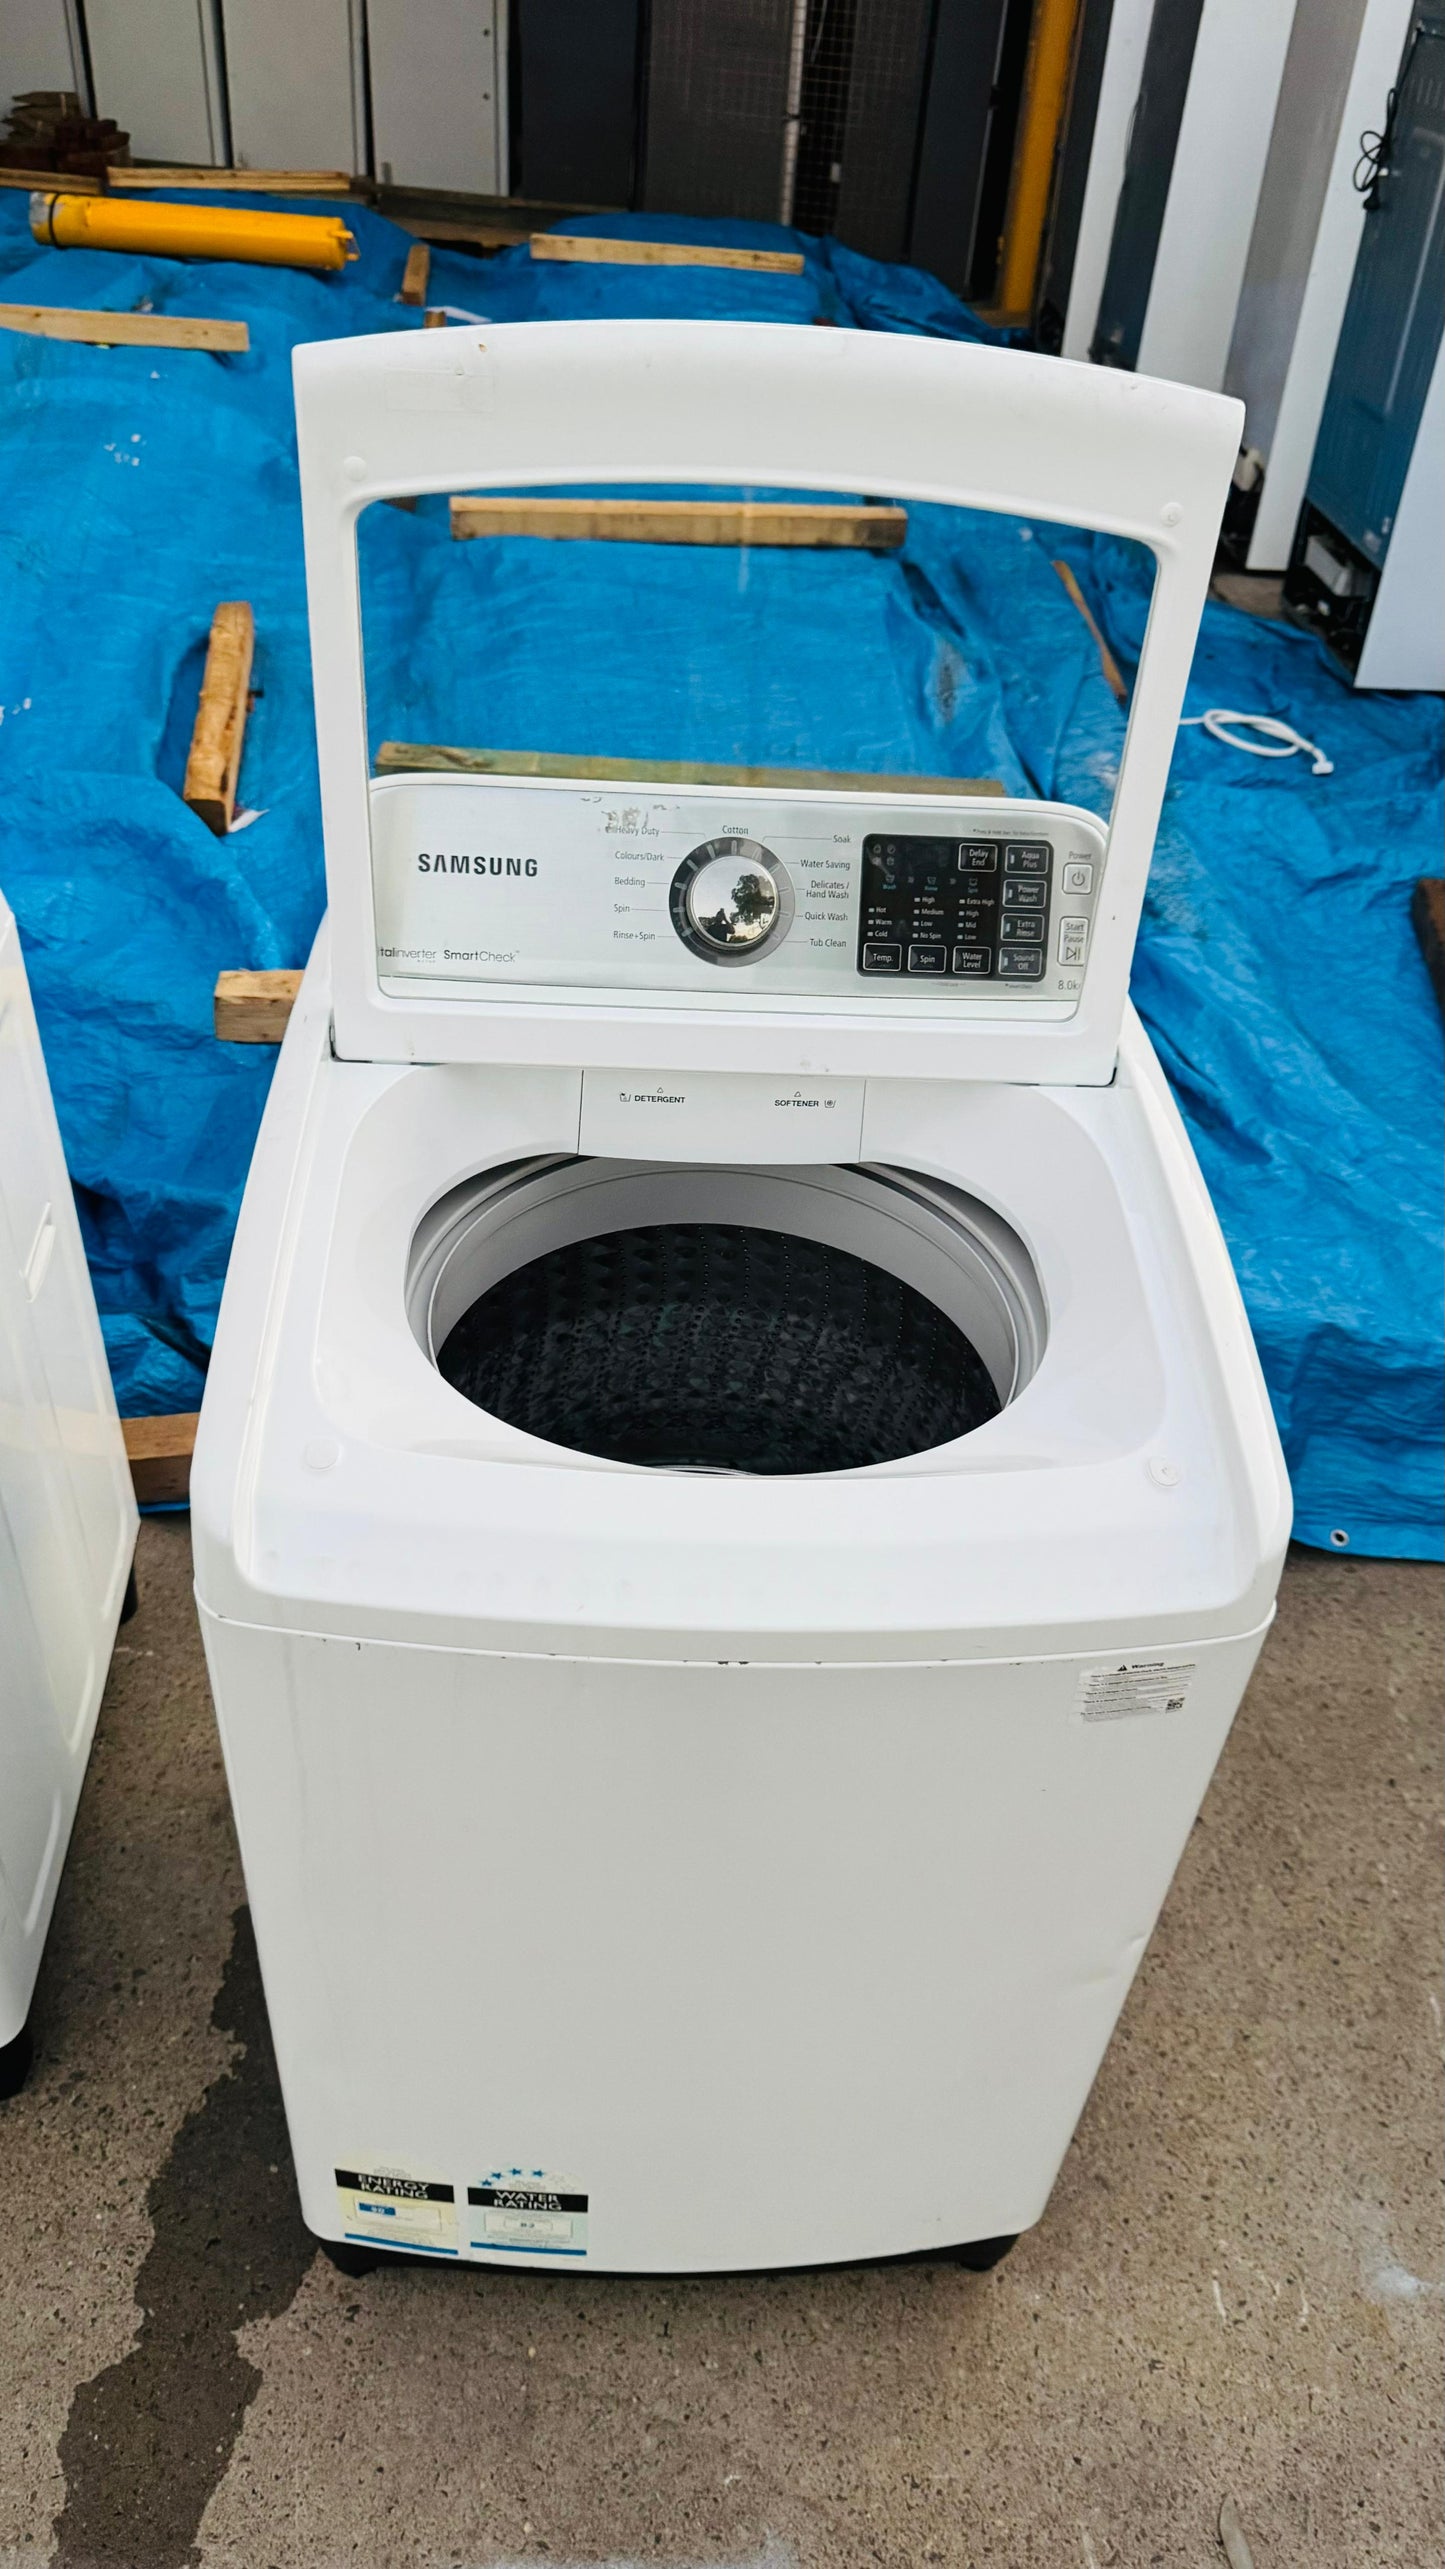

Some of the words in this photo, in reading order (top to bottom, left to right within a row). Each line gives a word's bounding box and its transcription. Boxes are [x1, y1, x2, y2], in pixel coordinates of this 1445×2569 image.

[616, 827, 639, 837] Heavy
[641, 827, 660, 837] Duty
[722, 825, 749, 835] Cotton
[833, 835, 851, 843] Soak
[615, 851, 665, 861] Colours/Dark
[969, 849, 989, 858] Delay
[1021, 851, 1040, 860] Aqua
[1068, 851, 1092, 860] Power
[418, 853, 538, 877] SAMSUNG
[801, 859, 824, 868] Water
[825, 860, 851, 871] Saving
[971, 858, 985, 866] End
[1023, 860, 1037, 868] Plus
[614, 877, 646, 888] Bedding
[811, 880, 845, 889] Delicates
[806, 890, 826, 899] Hand
[827, 890, 849, 899] Wash
[922, 897, 936, 905] High
[982, 899, 995, 907] High
[614, 904, 630, 914] Spin
[805, 912, 825, 921] Quick
[827, 912, 848, 921] Wash
[966, 910, 979, 918] High
[1017, 920, 1035, 928] Extra
[1065, 922, 1084, 931] Start
[613, 931, 656, 941] Rinse+Spin
[810, 938, 823, 947] Tub
[825, 938, 847, 948] Clean
[920, 955, 936, 964] Spin
[962, 952, 983, 960] Water
[963, 960, 981, 968] Level
[1057, 980, 1081, 990] 8.0k
[634, 1094, 686, 1104] DETERGENT
[774, 1099, 820, 1107] SOFTENER
[358, 2173, 430, 2191] ENERGY
[361, 2182, 429, 2199] RATING
[496, 2191, 559, 2202] WATER
[493, 2199, 562, 2211] RATING
